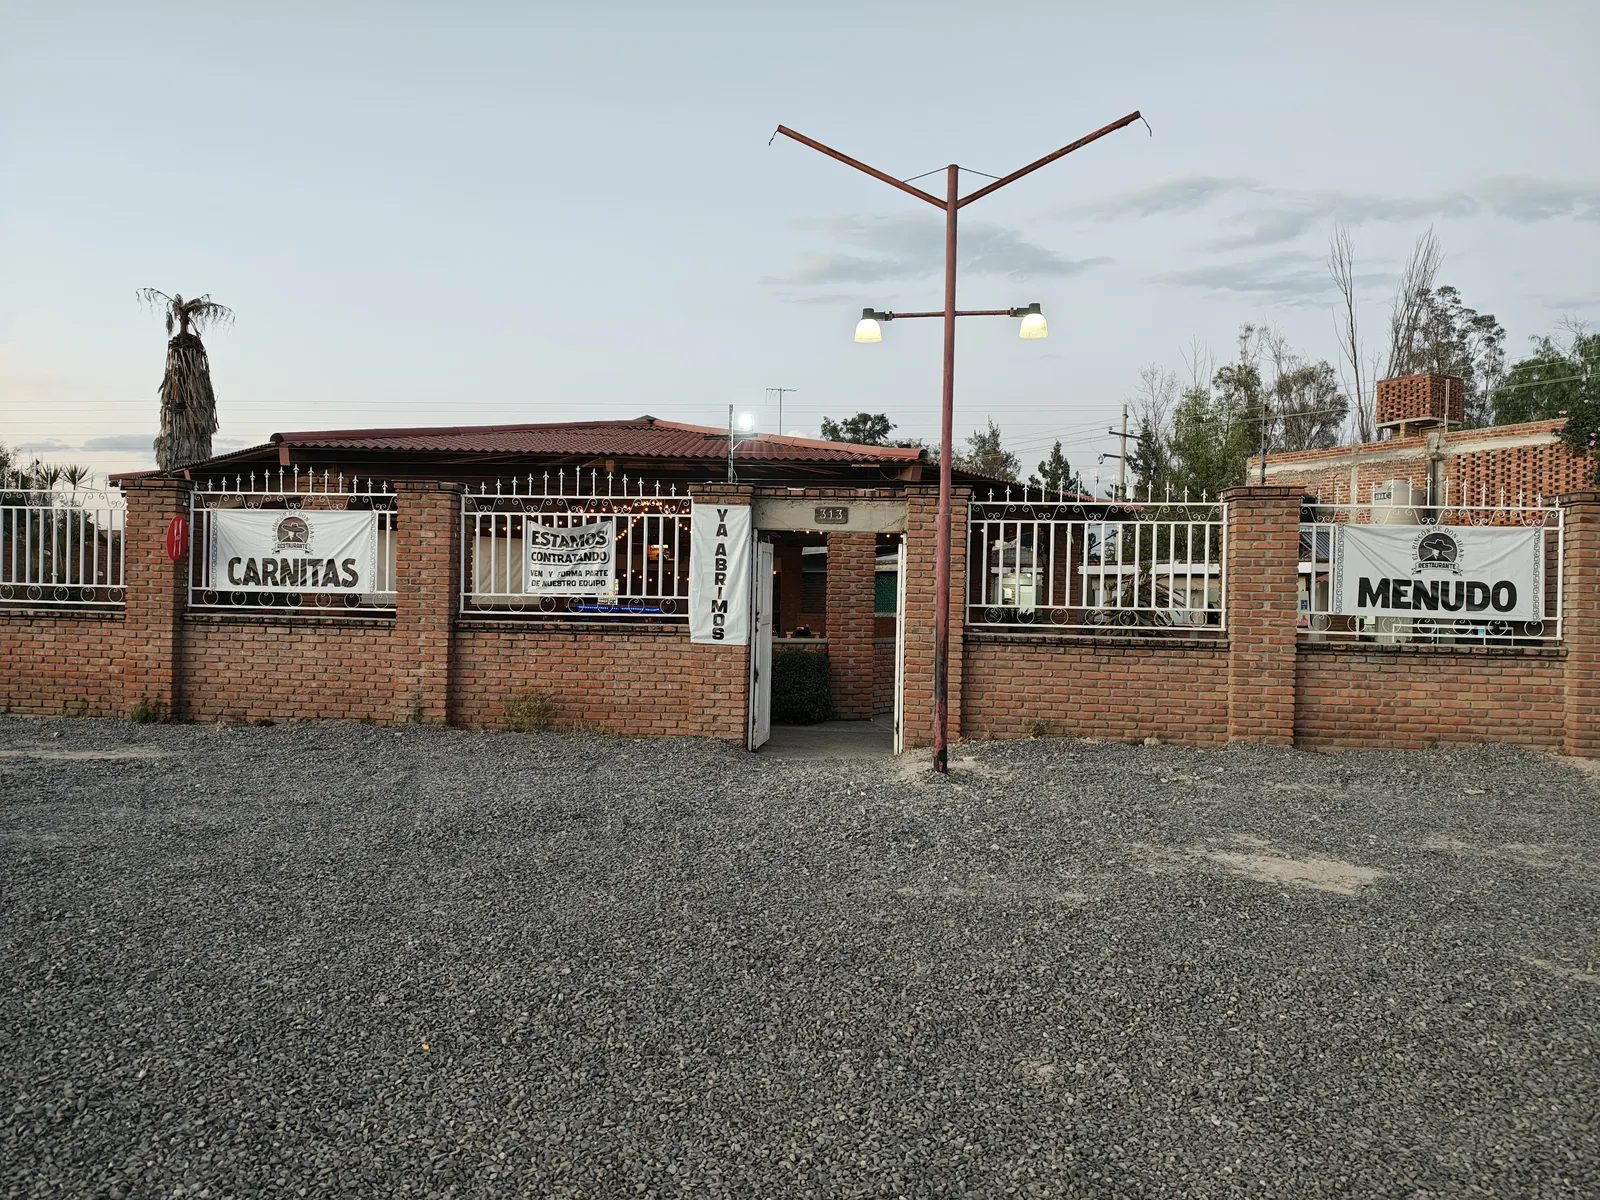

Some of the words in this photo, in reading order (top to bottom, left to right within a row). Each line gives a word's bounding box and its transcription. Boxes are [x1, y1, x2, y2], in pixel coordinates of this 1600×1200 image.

[297, 511, 311, 522] DON
[819, 508, 843, 520] 313
[715, 509, 728, 537] YA
[531, 530, 608, 549] ESTAMOS
[1443, 527, 1459, 539] DON
[1456, 539, 1465, 559] JUAN
[531, 551, 608, 564] CONTRATANDO
[227, 556, 359, 588] CARNITAS
[530, 569, 543, 578] VEN
[548, 570, 554, 578] Y
[584, 569, 609, 577] PARTE
[1417, 562, 1457, 570] RESTAURANTE
[531, 579, 541, 587] DE
[542, 579, 577, 587] NUESTRO
[578, 579, 606, 587] EQUIPO
[711, 543, 728, 641] ABRIMOS
[1357, 577, 1517, 612] MENUDO
